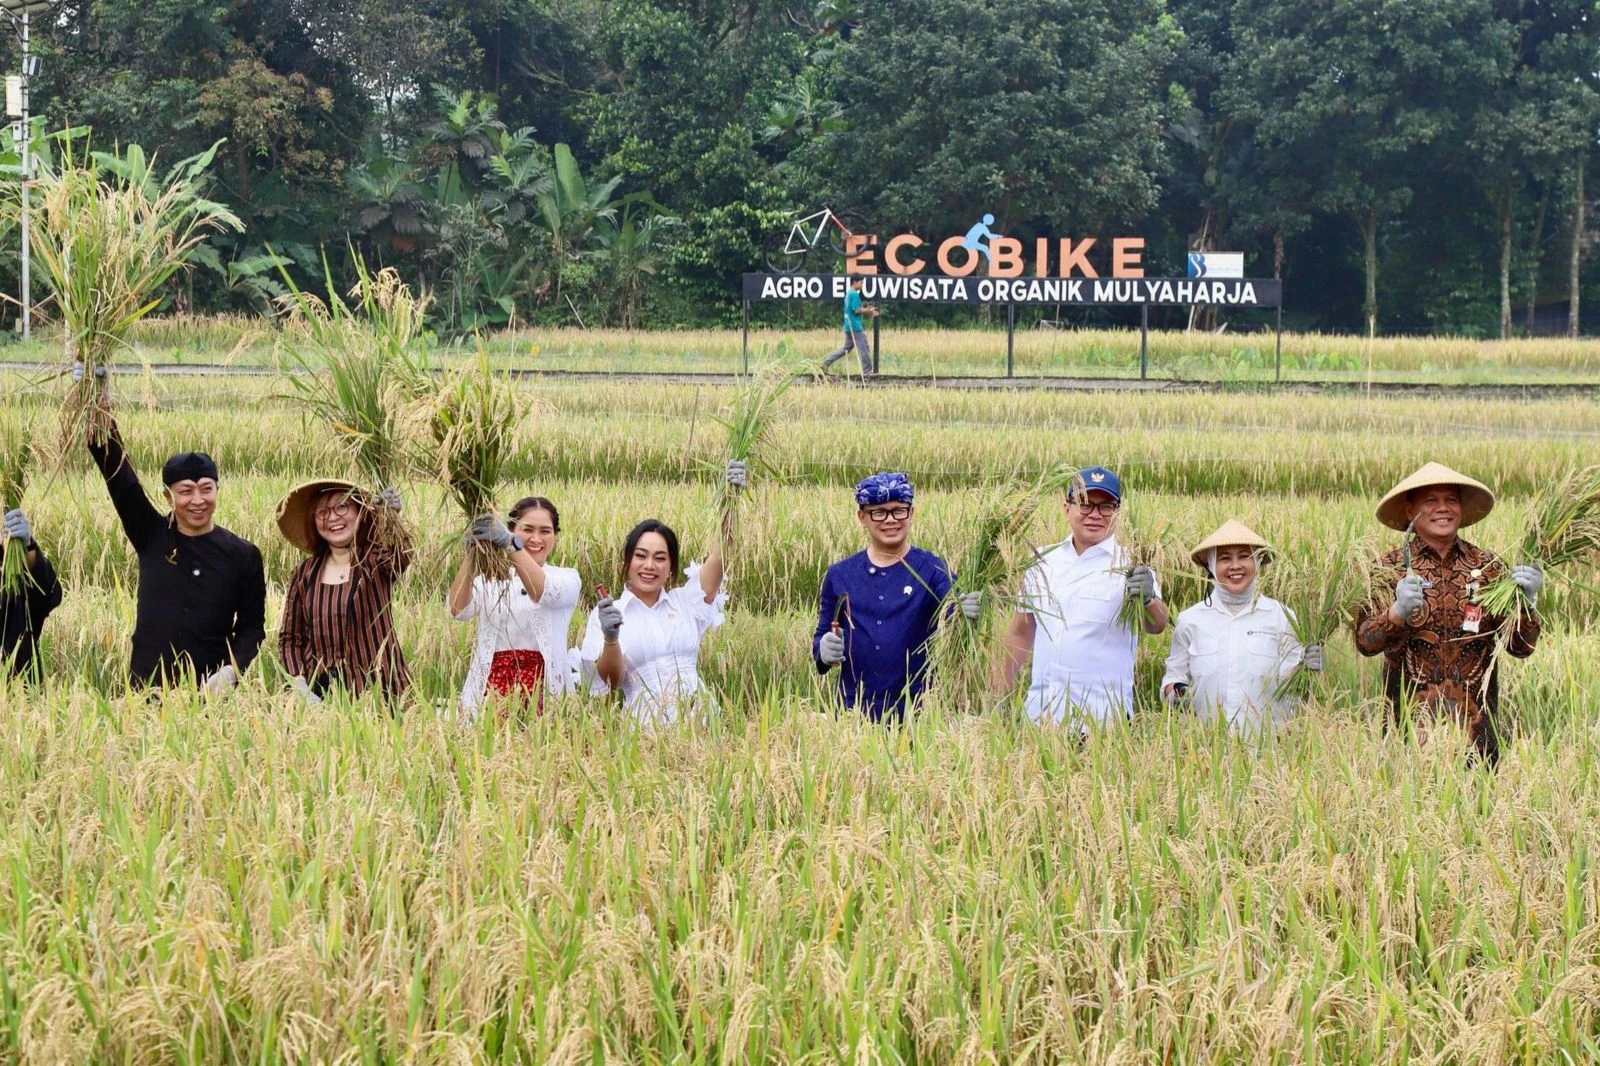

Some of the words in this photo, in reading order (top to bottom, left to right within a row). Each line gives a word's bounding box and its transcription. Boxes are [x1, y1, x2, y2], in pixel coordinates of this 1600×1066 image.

[845, 234, 1145, 278] ECOBIKE
[761, 276, 823, 299] AGRO
[978, 279, 1083, 302] ORGANIK
[1093, 280, 1257, 304] MULYAHARJA
